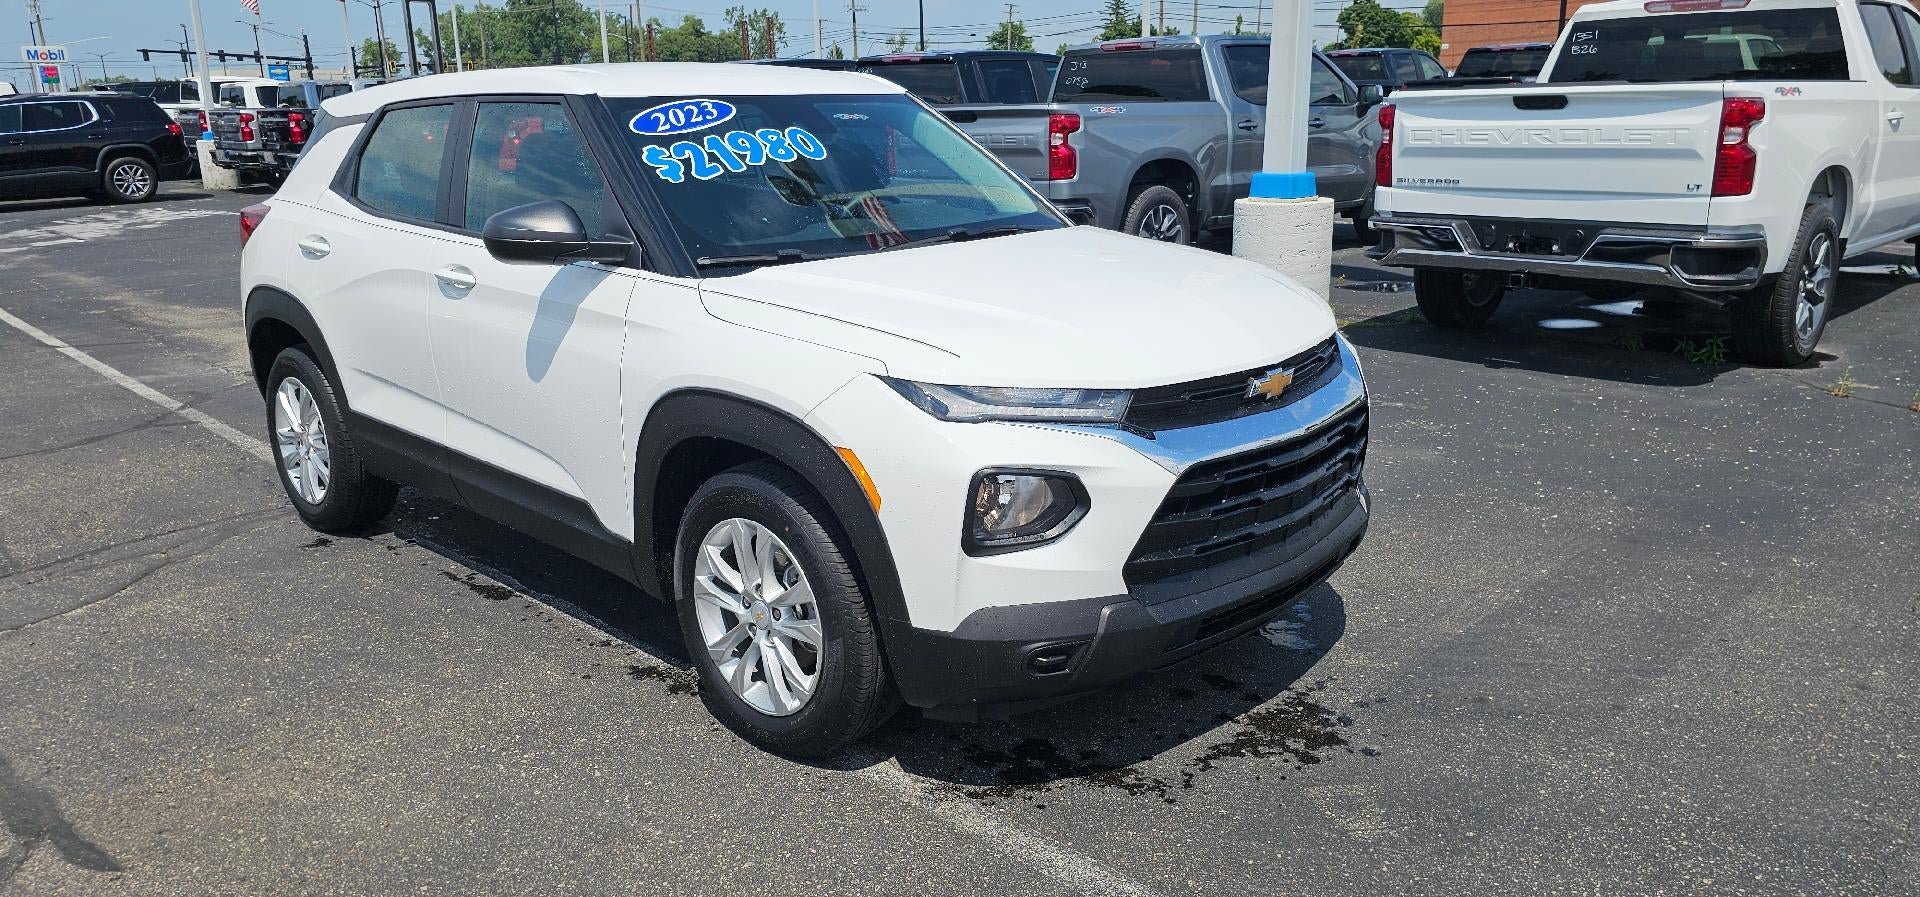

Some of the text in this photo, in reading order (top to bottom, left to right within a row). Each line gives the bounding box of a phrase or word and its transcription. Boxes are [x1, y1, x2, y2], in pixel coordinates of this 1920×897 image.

[1572, 29, 1598, 42] 1351
[26, 49, 65, 60] Mobil
[1571, 44, 1598, 55] B26
[650, 101, 718, 133] 2023
[1409, 128, 1690, 145] CHEVROLET
[642, 127, 827, 183] $21980
[1396, 177, 1460, 185] SILVERADO
[1686, 183, 1703, 192] LT
